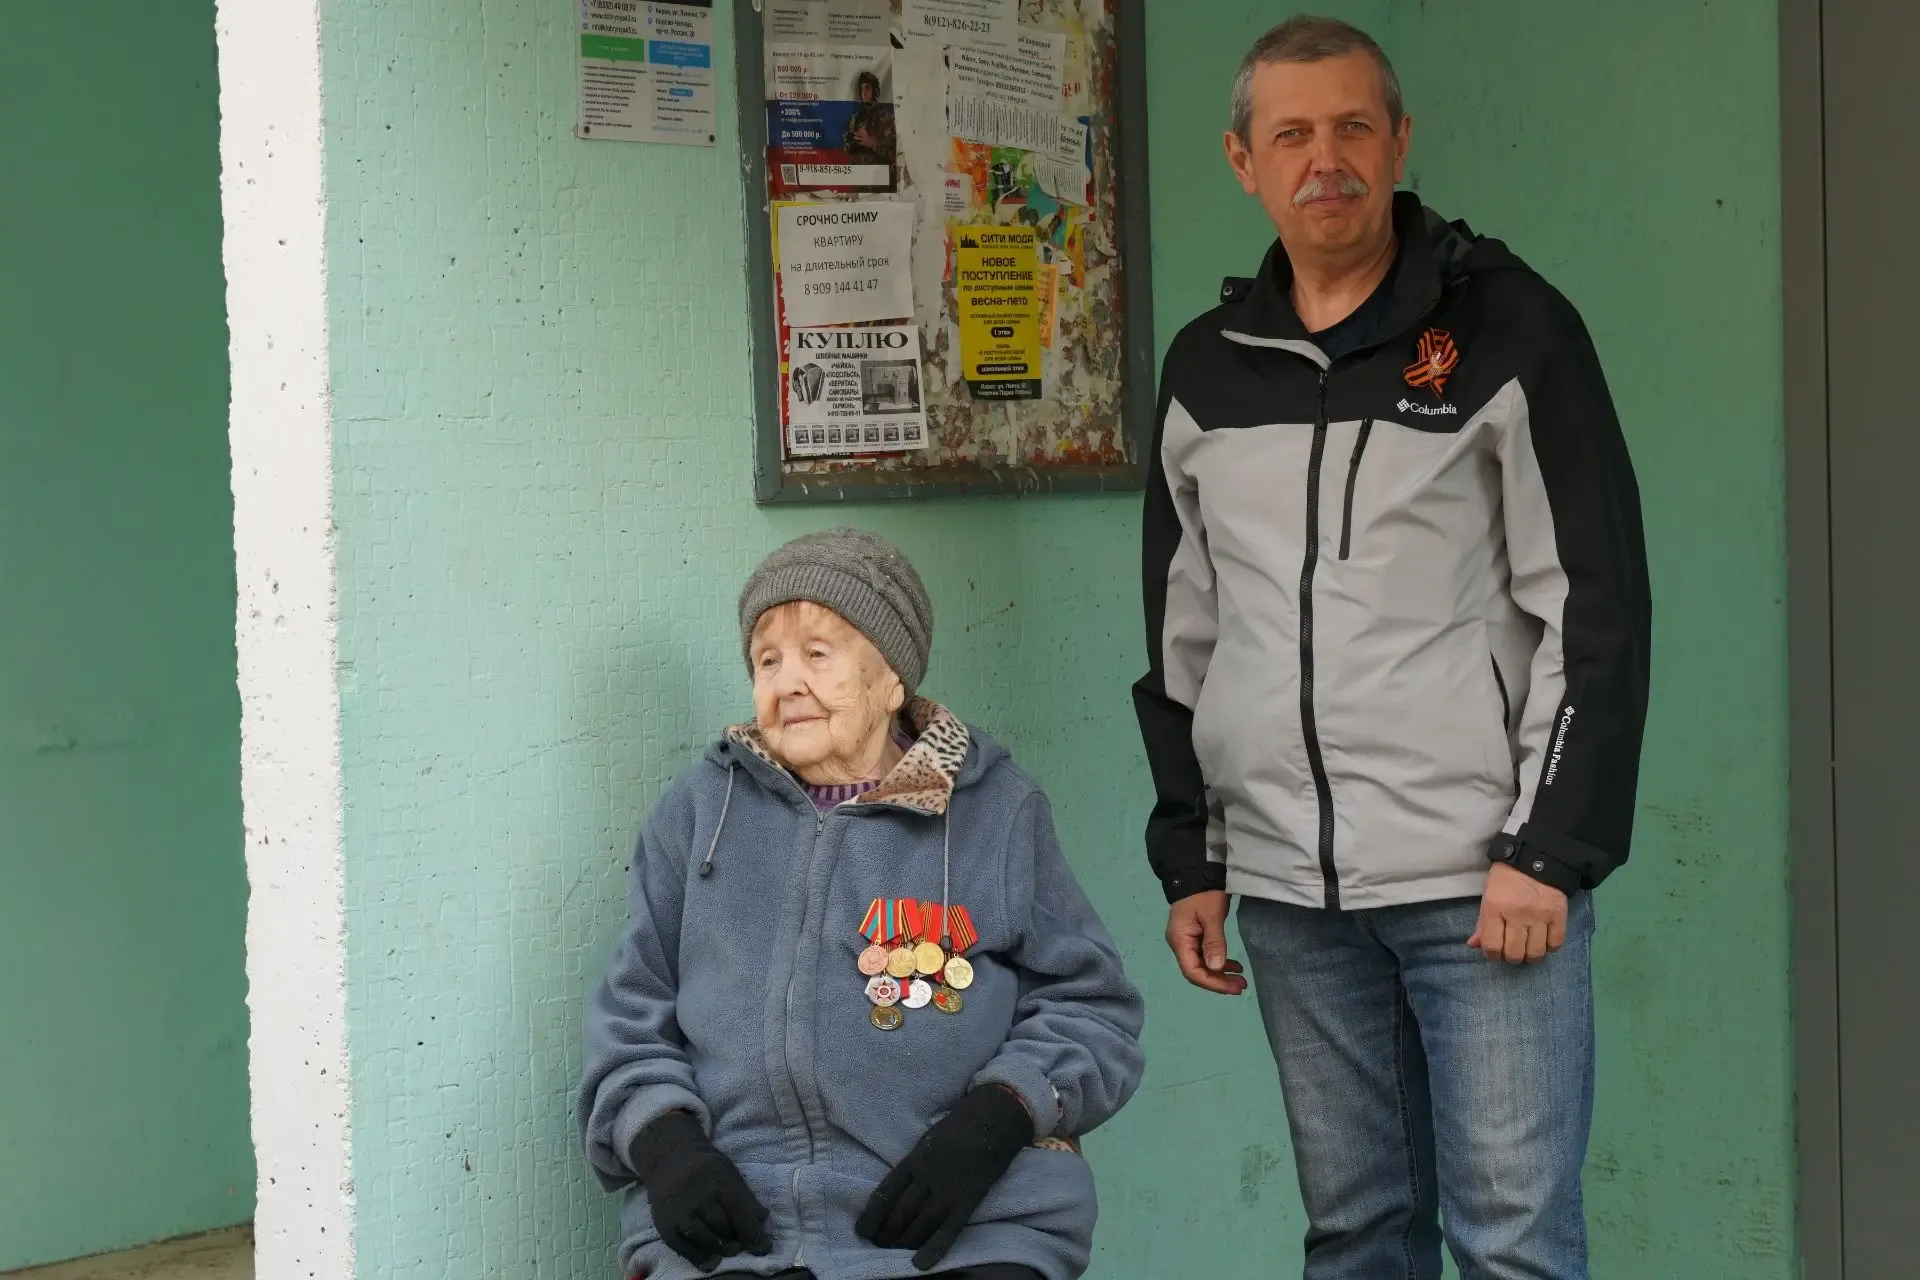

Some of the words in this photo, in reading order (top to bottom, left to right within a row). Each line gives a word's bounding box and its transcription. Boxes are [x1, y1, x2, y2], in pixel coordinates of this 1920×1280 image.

[924, 14, 990, 33] 8(912)-826-22-23
[781, 130, 790, 138] До
[796, 214, 838, 226] СРОЧНО
[841, 212, 878, 224] СНИМУ
[814, 234, 864, 248] КВАРТИРУ
[981, 234, 1005, 243] СИТИ
[1008, 234, 1033, 244] МОДА
[790, 263, 802, 272] на
[805, 256, 865, 273] длительный
[867, 257, 890, 270] срок
[982, 257, 1016, 267] НОВОЕ
[962, 271, 1033, 280] ПОСТУПЛЕНИЕ
[804, 283, 810, 295] 8
[812, 282, 831, 295] 909
[835, 282, 851, 294] 144
[853, 280, 864, 292] 41
[867, 279, 878, 290] 47
[972, 297, 1028, 306] весна-лето
[797, 332, 908, 349] КУПЛЮ
[1410, 402, 1457, 415] Columbia
[1554, 716, 1571, 753] Columbia
[1545, 753, 1561, 785] Fashion
